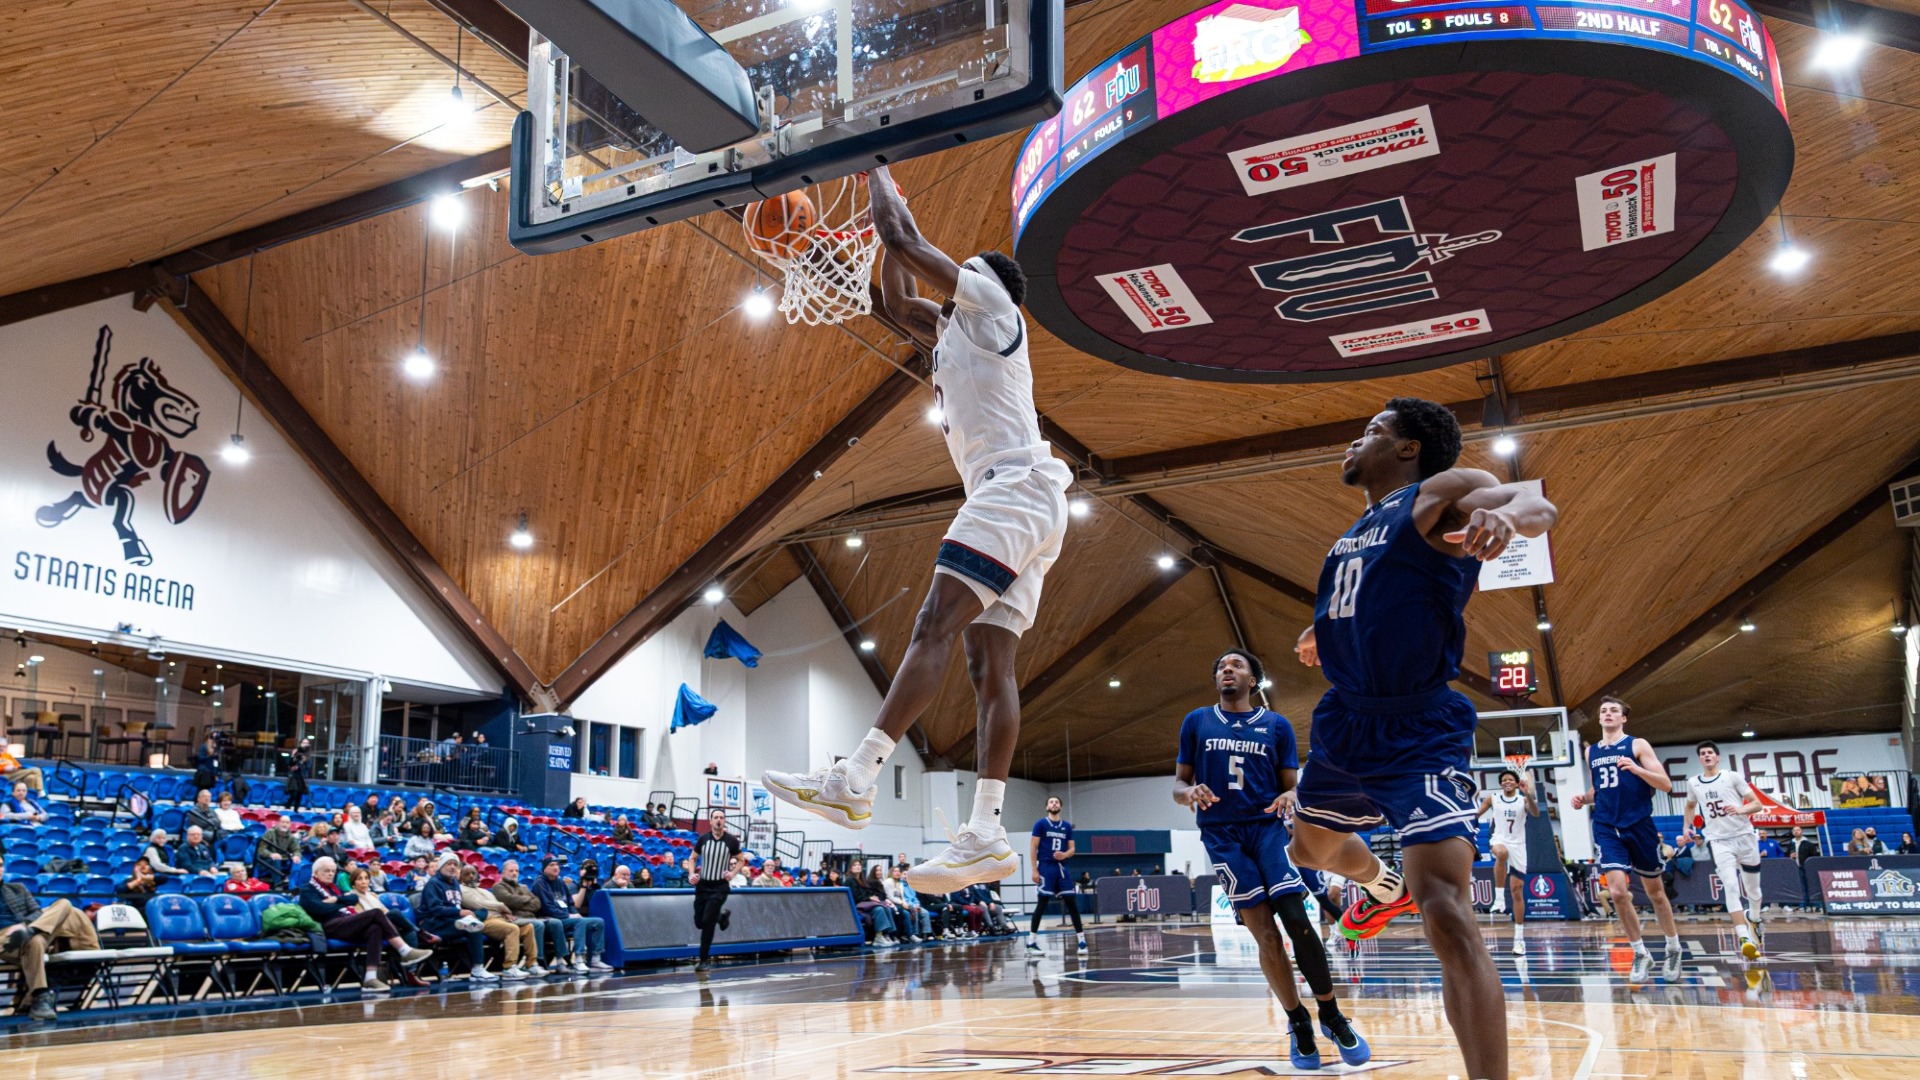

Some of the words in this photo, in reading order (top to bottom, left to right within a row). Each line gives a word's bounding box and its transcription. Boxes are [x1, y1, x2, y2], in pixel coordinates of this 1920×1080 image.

[1386, 20, 1415, 35] TOL
[1421, 18, 1432, 30] 3
[1445, 13, 1492, 28] FOULS
[1499, 12, 1509, 23] 8
[1576, 11, 1613, 30] 2ND
[1617, 14, 1660, 36] HALF
[1105, 64, 1140, 109] FDU
[1073, 90, 1096, 127] 62
[1066, 147, 1080, 162] TOL
[1082, 140, 1088, 150] 1
[1094, 116, 1123, 141] FOULS
[1126, 110, 1133, 121] 9
[1313, 127, 1423, 158] Hackensack
[1317, 140, 1327, 148] of
[1330, 135, 1356, 146] years
[1281, 144, 1317, 158] serving
[1343, 136, 1428, 162] TOYOTA
[1248, 157, 1309, 182] 50
[1601, 169, 1638, 200] 50
[1605, 210, 1622, 243] TOYOTA
[1625, 196, 1637, 238] Hackensack
[1231, 196, 1440, 322] FDU
[1127, 273, 1161, 308] Hackensack
[1140, 269, 1171, 298] TOYOTA
[1156, 306, 1191, 326] 50
[1339, 331, 1404, 345] TOYOTA
[1431, 317, 1480, 333] 50
[1343, 332, 1426, 349] Hackensack
[1327, 525, 1389, 557] ONEHILL
[14, 551, 117, 596] STRATIS
[123, 572, 194, 611] ARENA
[1328, 556, 1363, 620] 10
[1205, 738, 1267, 756] STONEHILL
[1228, 755, 1244, 790] 5
[1592, 755, 1624, 768] STONEHI
[1599, 766, 1619, 789] 33
[714, 784, 720, 799] 4
[727, 785, 738, 801] 40
[1706, 800, 1727, 819] 35
[1752, 814, 1777, 822] SERVE
[1794, 813, 1815, 822] HERE
[1506, 819, 1515, 834] 7
[1052, 838, 1061, 851] 13
[1831, 880, 1859, 888] FREE
[1833, 871, 1853, 879] WIN
[1126, 888, 1160, 912] FDU
[1828, 890, 1867, 898] PRIZES!
[1830, 902, 1851, 910] Text
[1853, 901, 1883, 910] "FDU"
[1885, 901, 1900, 909] TO
